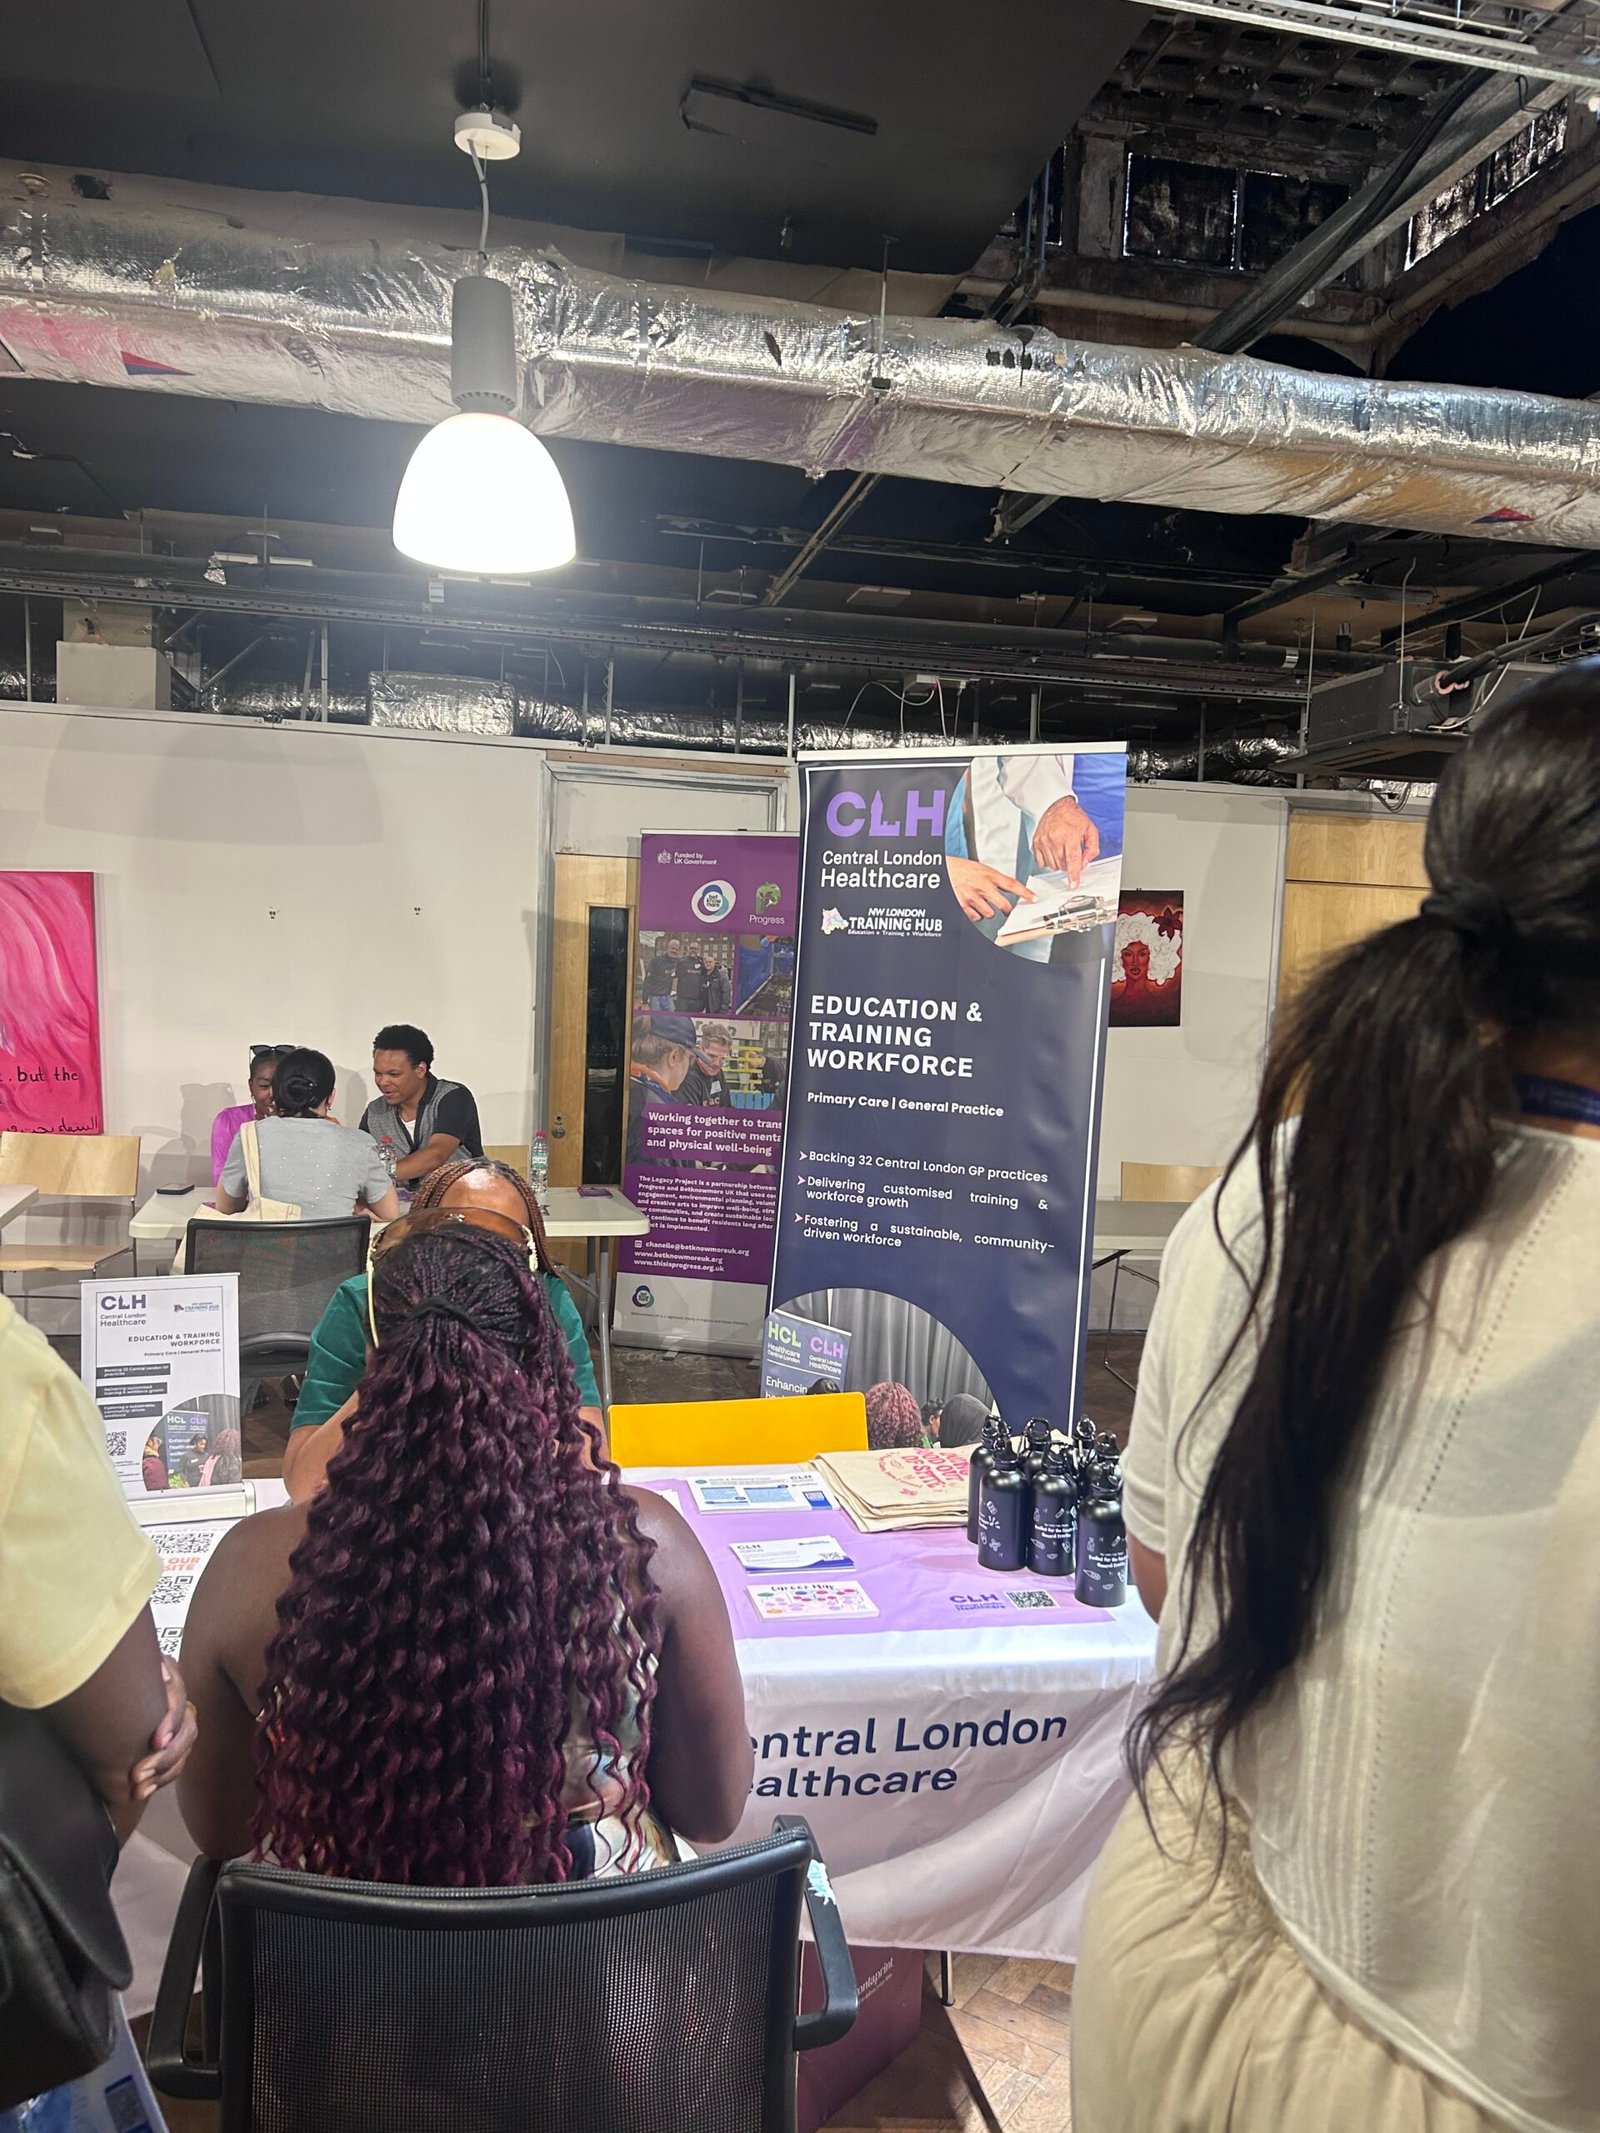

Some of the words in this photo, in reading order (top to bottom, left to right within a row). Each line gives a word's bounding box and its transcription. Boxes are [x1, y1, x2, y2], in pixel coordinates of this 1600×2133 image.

[826, 790, 945, 837] CLH
[822, 850, 879, 866] Central
[883, 850, 942, 866] London
[821, 867, 941, 889] Healthcare
[749, 914, 785, 925] Progress
[868, 908, 886, 917] NW
[886, 908, 926, 918] LONDON
[849, 917, 911, 930] TRAINING
[915, 918, 943, 931] HUB
[811, 994, 957, 1021] EDUCATION
[966, 1001, 983, 1022] &
[809, 1021, 932, 1047] TRAINING
[807, 1048, 974, 1078] WORKFORCE
[17, 1065, 45, 1082] but
[54, 1066, 79, 1081] the
[807, 1092, 856, 1108] Primary
[858, 1096, 889, 1108] Care
[899, 1099, 949, 1113] General
[951, 1103, 1004, 1117] Practice
[648, 1112, 691, 1125] Working
[694, 1115, 740, 1127] together
[743, 1118, 754, 1127] to
[648, 1125, 683, 1136] spaces
[686, 1126, 702, 1137] for
[705, 1128, 747, 1140] positive
[647, 1138, 666, 1147] and
[668, 1139, 712, 1151] physical
[715, 1142, 772, 1157] well-being
[809, 1151, 855, 1167] Backing
[858, 1155, 873, 1166] 32
[876, 1156, 920, 1171] Central
[923, 1160, 965, 1176] London
[968, 1165, 985, 1176] GP
[988, 1166, 1048, 1183] practices
[675, 1178, 697, 1186] Project
[711, 1181, 748, 1189] partnership
[749, 1183, 776, 1191] between
[679, 1194, 724, 1202] environmental
[725, 1197, 754, 1205] planning,
[806, 1190, 864, 1204] workforce
[867, 1196, 909, 1208] growth
[807, 1176, 865, 1193] Delivering
[883, 1183, 953, 1200] customised
[970, 1192, 1019, 1210] training
[1037, 1199, 1048, 1211] &
[649, 1207, 690, 1215] communities,
[743, 1221, 757, 1229] long
[803, 1227, 839, 1241] driven
[842, 1232, 902, 1248] workforce
[804, 1214, 858, 1232] Fostering
[870, 1222, 878, 1232] a
[890, 1223, 963, 1243] sustainable,
[974, 1234, 1055, 1254] community-
[101, 1294, 147, 1311] CLH
[128, 1334, 173, 1342] EDUCATION
[170, 1339, 221, 1347] WORKFORCE
[768, 1321, 801, 1348] HCL
[810, 1336, 844, 1359] CLH
[768, 1342, 801, 1359] Healthcare
[809, 1361, 841, 1374] Healthcare
[950, 1594, 999, 1603] CLH
[750, 1718, 876, 1759] ntral
[895, 1709, 1068, 1752] London
[748, 1766, 958, 1798] althcare
